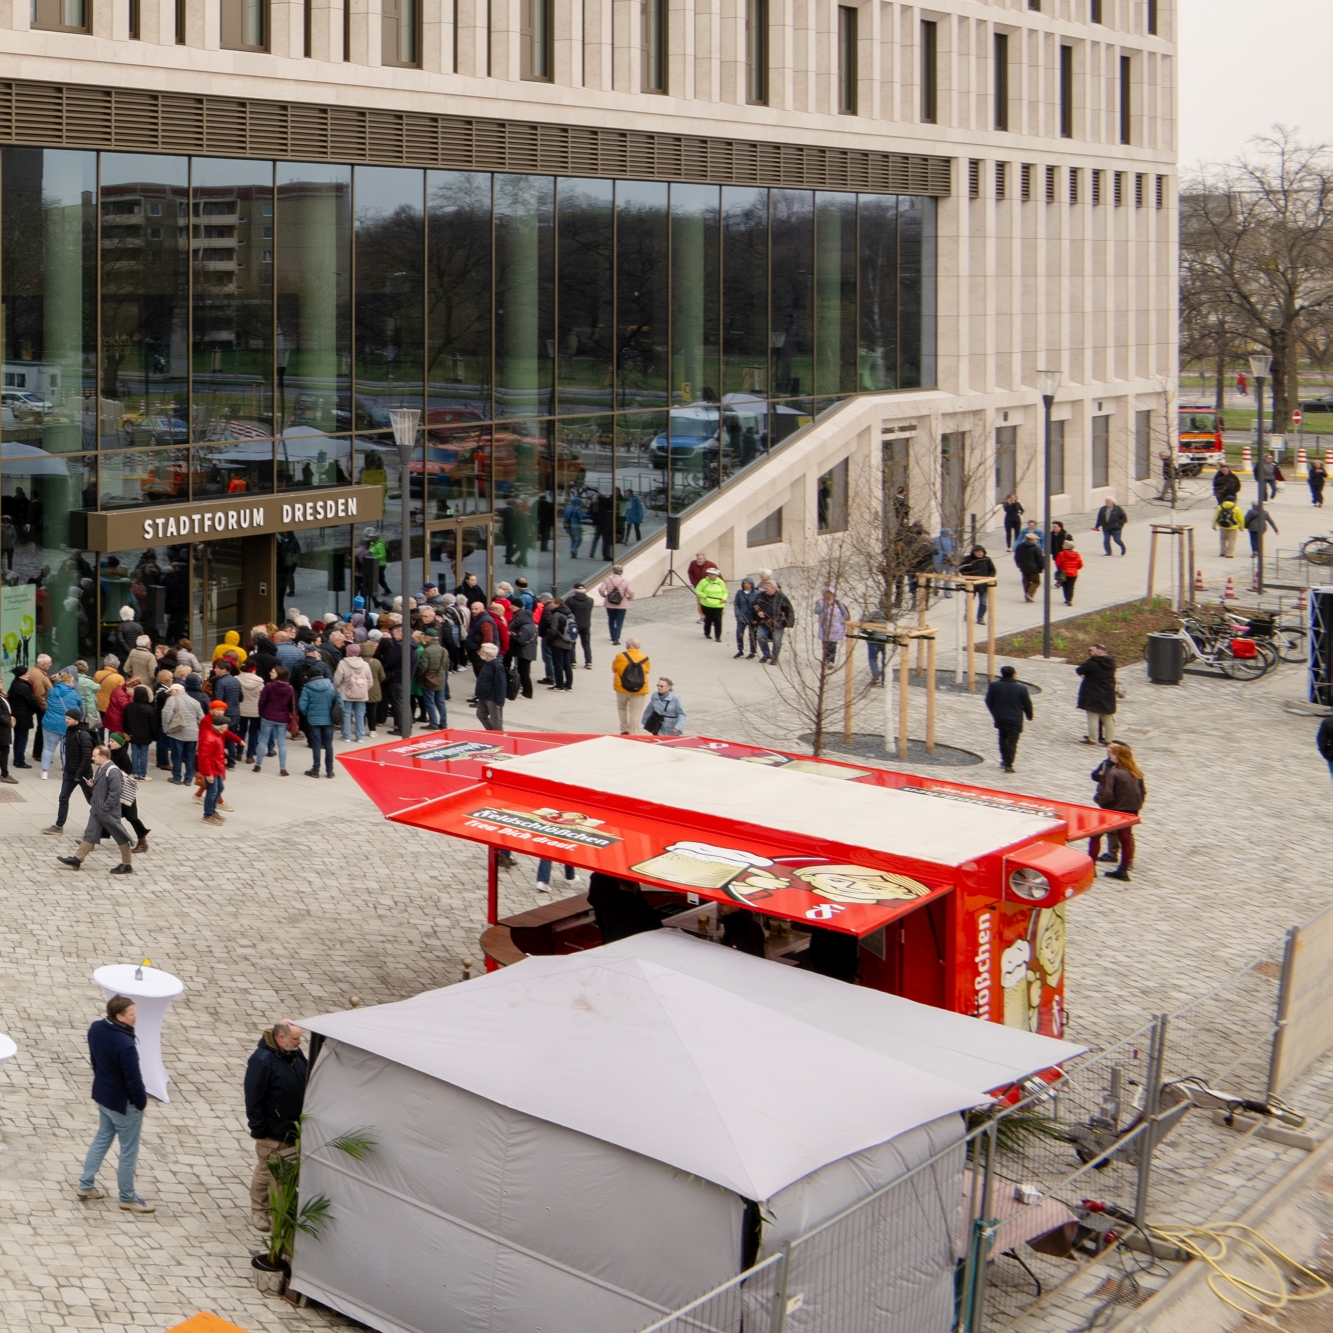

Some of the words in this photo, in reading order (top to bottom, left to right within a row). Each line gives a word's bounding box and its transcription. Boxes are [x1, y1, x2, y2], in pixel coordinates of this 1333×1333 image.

[143, 507, 264, 540] STADTFORUM
[282, 497, 358, 524] DRESDEN
[473, 809, 610, 846] Feldschlößchen
[497, 826, 533, 840] Dich
[532, 835, 579, 851] drauf.
